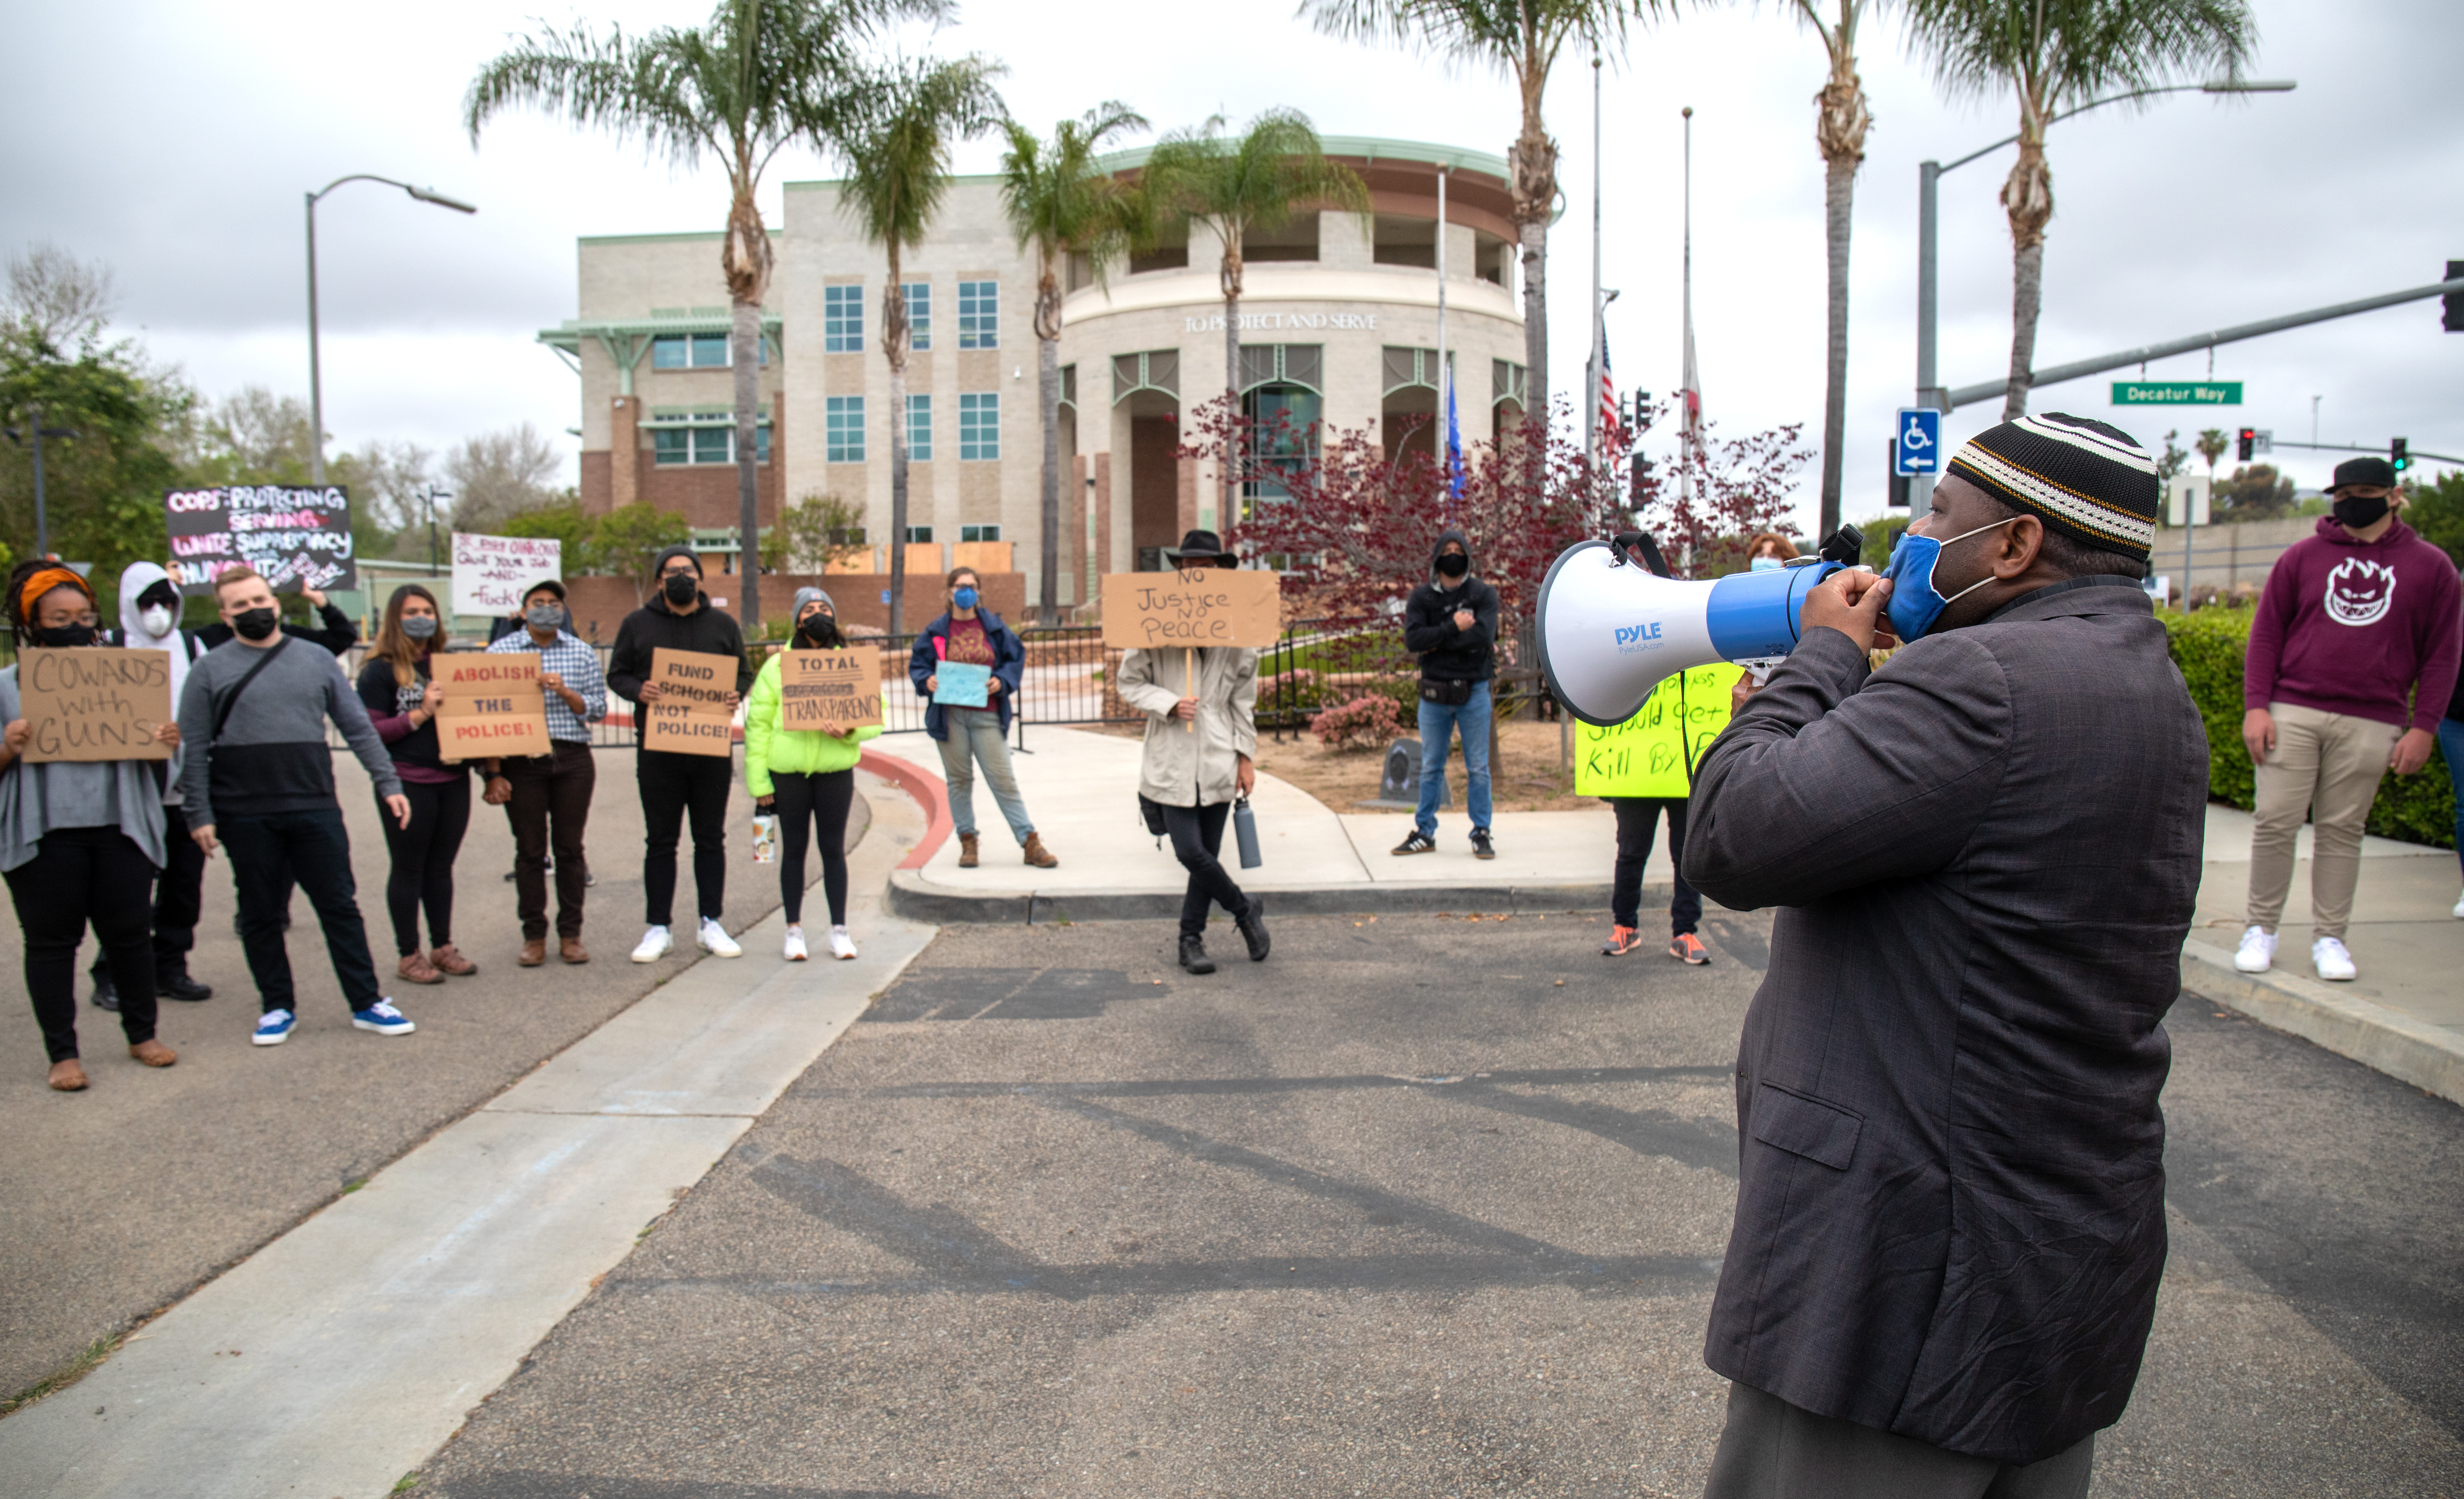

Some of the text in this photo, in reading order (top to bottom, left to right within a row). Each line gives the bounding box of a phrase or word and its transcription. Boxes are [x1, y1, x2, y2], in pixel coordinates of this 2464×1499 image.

[1185, 316, 1207, 333] TO
[1286, 312, 1328, 330] AND
[1330, 312, 1378, 330] SERVE
[2127, 386, 2226, 403] Decatur Way
[230, 485, 347, 510] PROTECTING
[228, 509, 319, 532] SERVING
[172, 531, 353, 559] WHITE SUPREMACY
[180, 557, 290, 585] HUMITY
[1137, 588, 1231, 611] Justice
[1615, 622, 1662, 645] PYLE
[1619, 642, 1665, 656] PyleUSA.com
[32, 652, 168, 693] COWARDS
[452, 665, 536, 682] ABOLISH
[668, 663, 714, 680] FUND
[799, 656, 859, 671] TOTAL
[57, 690, 134, 717] with
[473, 698, 512, 713] THE
[653, 704, 691, 718] NOT
[36, 717, 155, 755] GUNS
[455, 723, 534, 740] POLICE!
[657, 721, 730, 739] POLICE!
[1585, 747, 1630, 780] Kill
[1649, 742, 1678, 775] By
